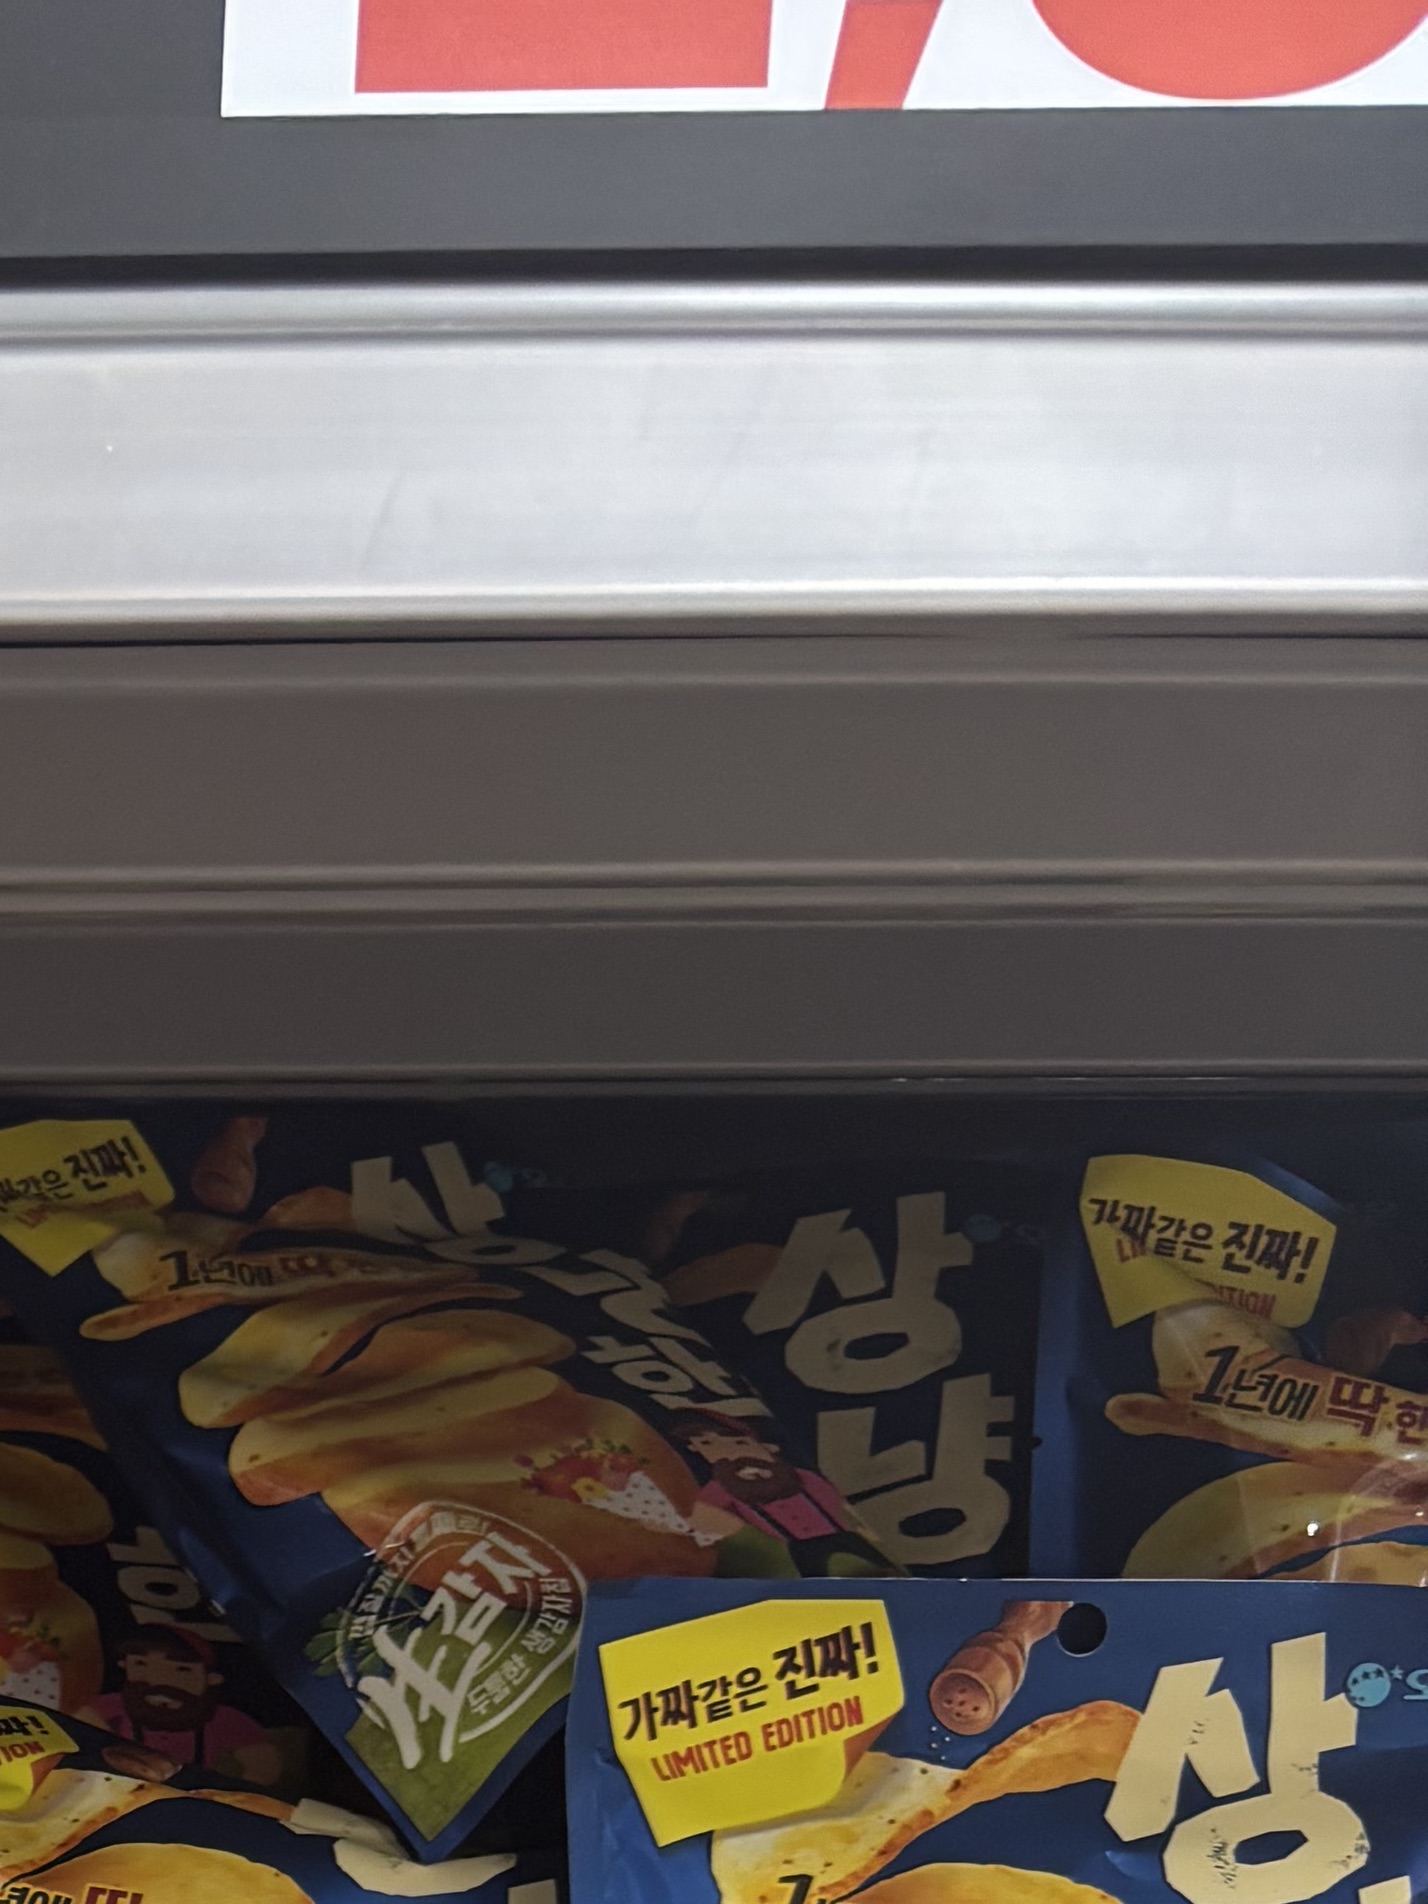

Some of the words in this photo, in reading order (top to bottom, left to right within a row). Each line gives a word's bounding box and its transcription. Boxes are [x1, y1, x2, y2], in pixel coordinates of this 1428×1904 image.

[63, 1135, 147, 1188] 진짜!
[160, 1250, 273, 1291] 1년에
[1222, 1222, 1319, 1285] 진짜!
[1192, 1345, 1319, 1423] 1년에
[1326, 1375, 1388, 1438] 딱
[619, 1670, 768, 1743] 가짜같은
[773, 1622, 880, 1688] 진짜!
[651, 1729, 752, 1785] LIMITED
[763, 1696, 864, 1754] EDITION
